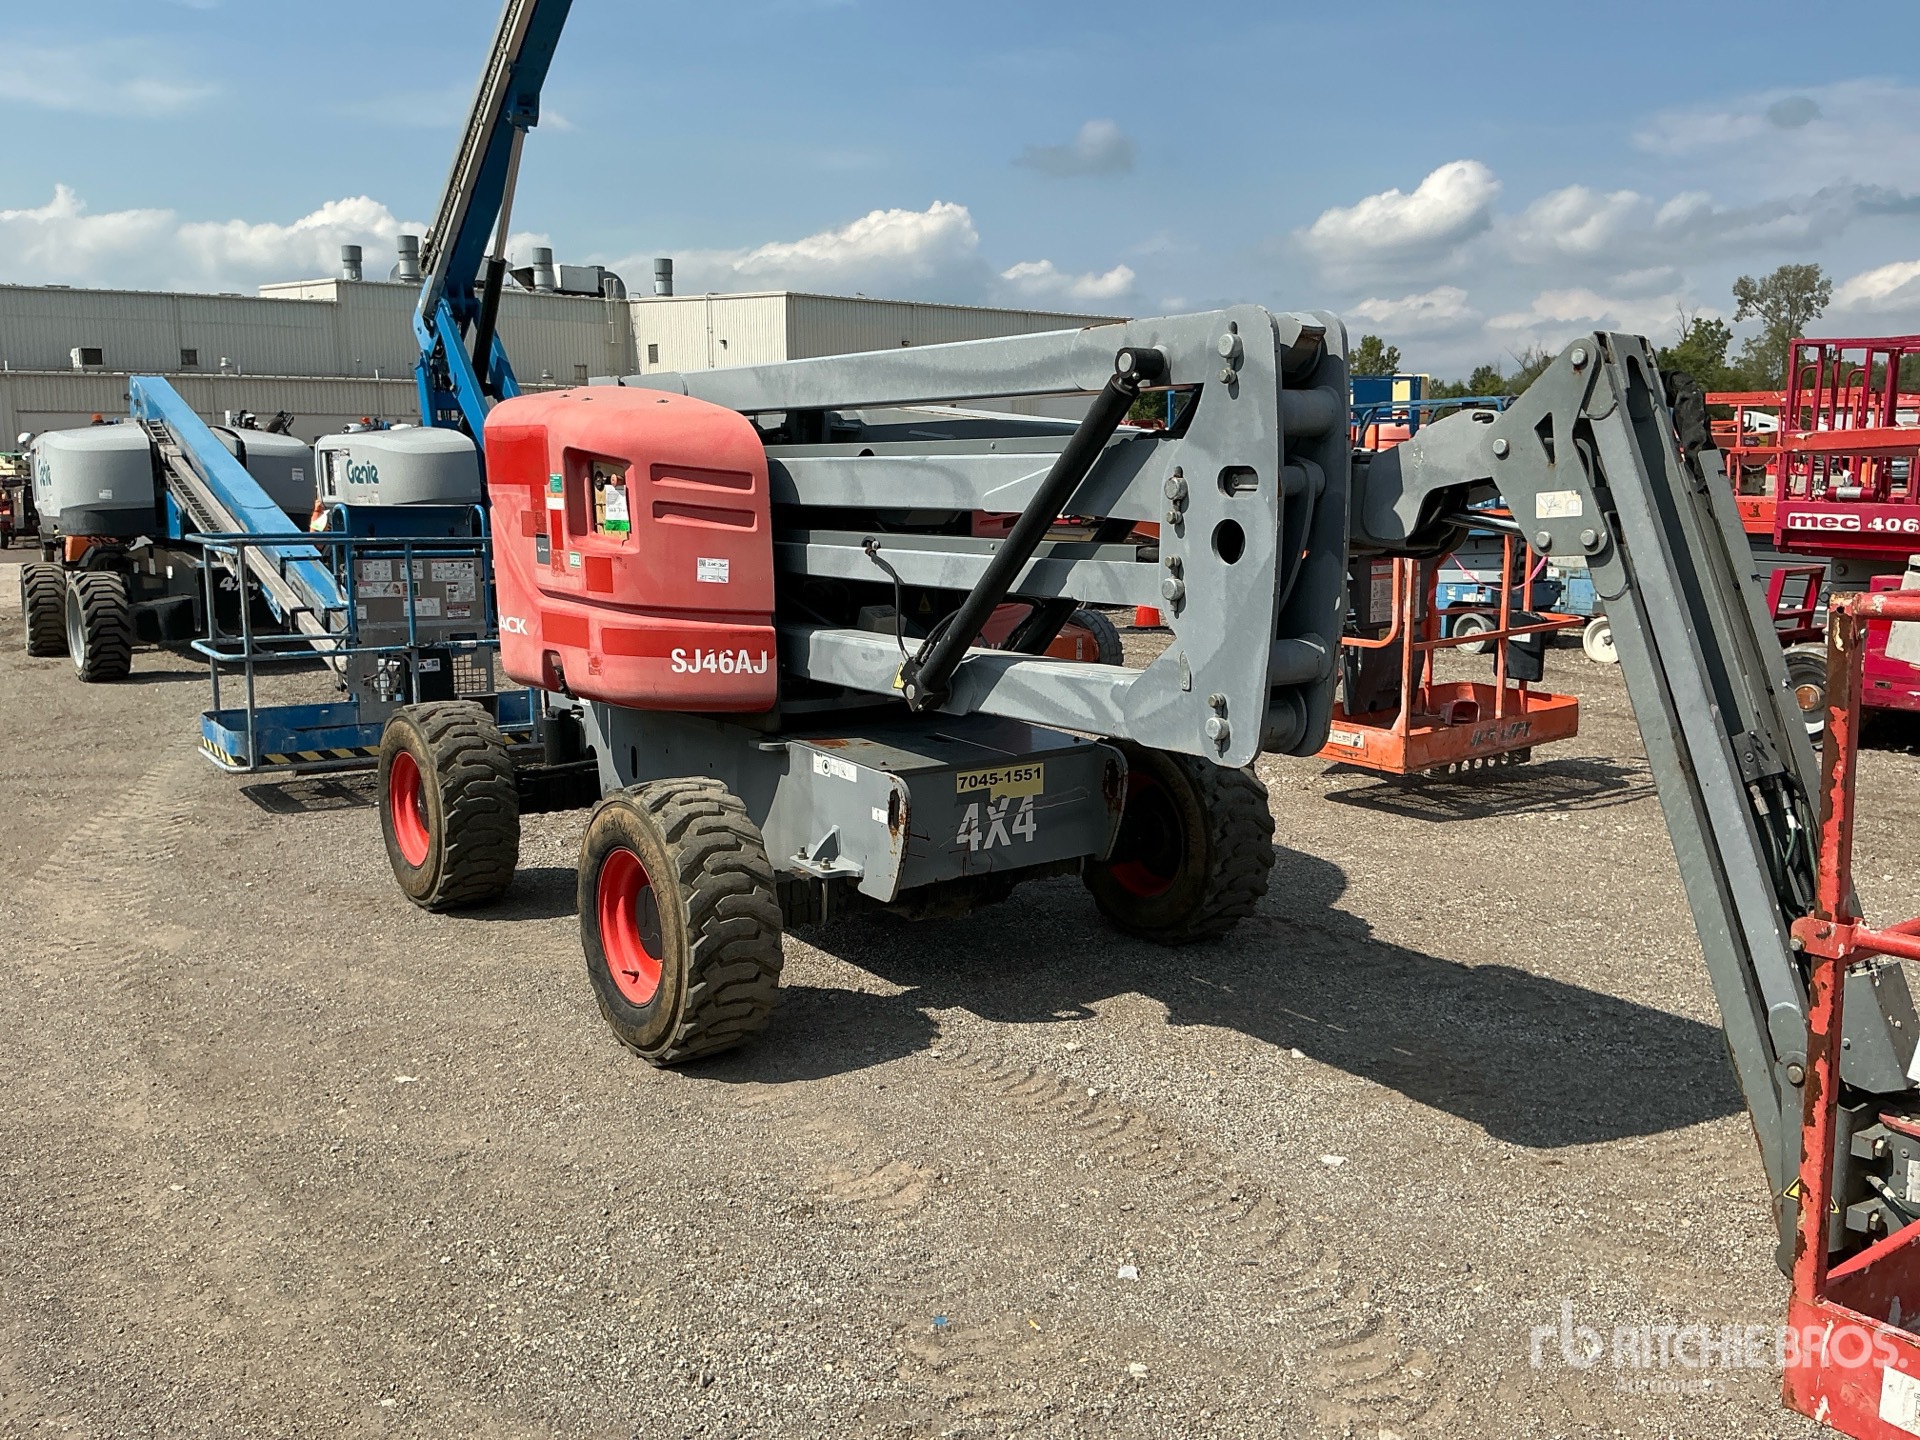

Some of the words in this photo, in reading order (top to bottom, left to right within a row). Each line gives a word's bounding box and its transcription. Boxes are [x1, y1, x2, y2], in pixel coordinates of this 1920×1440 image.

[346, 459, 380, 484] Genie
[1788, 515, 1859, 529] mec
[671, 648, 768, 674] SJ46AJ
[958, 767, 1041, 789] 7045-1551
